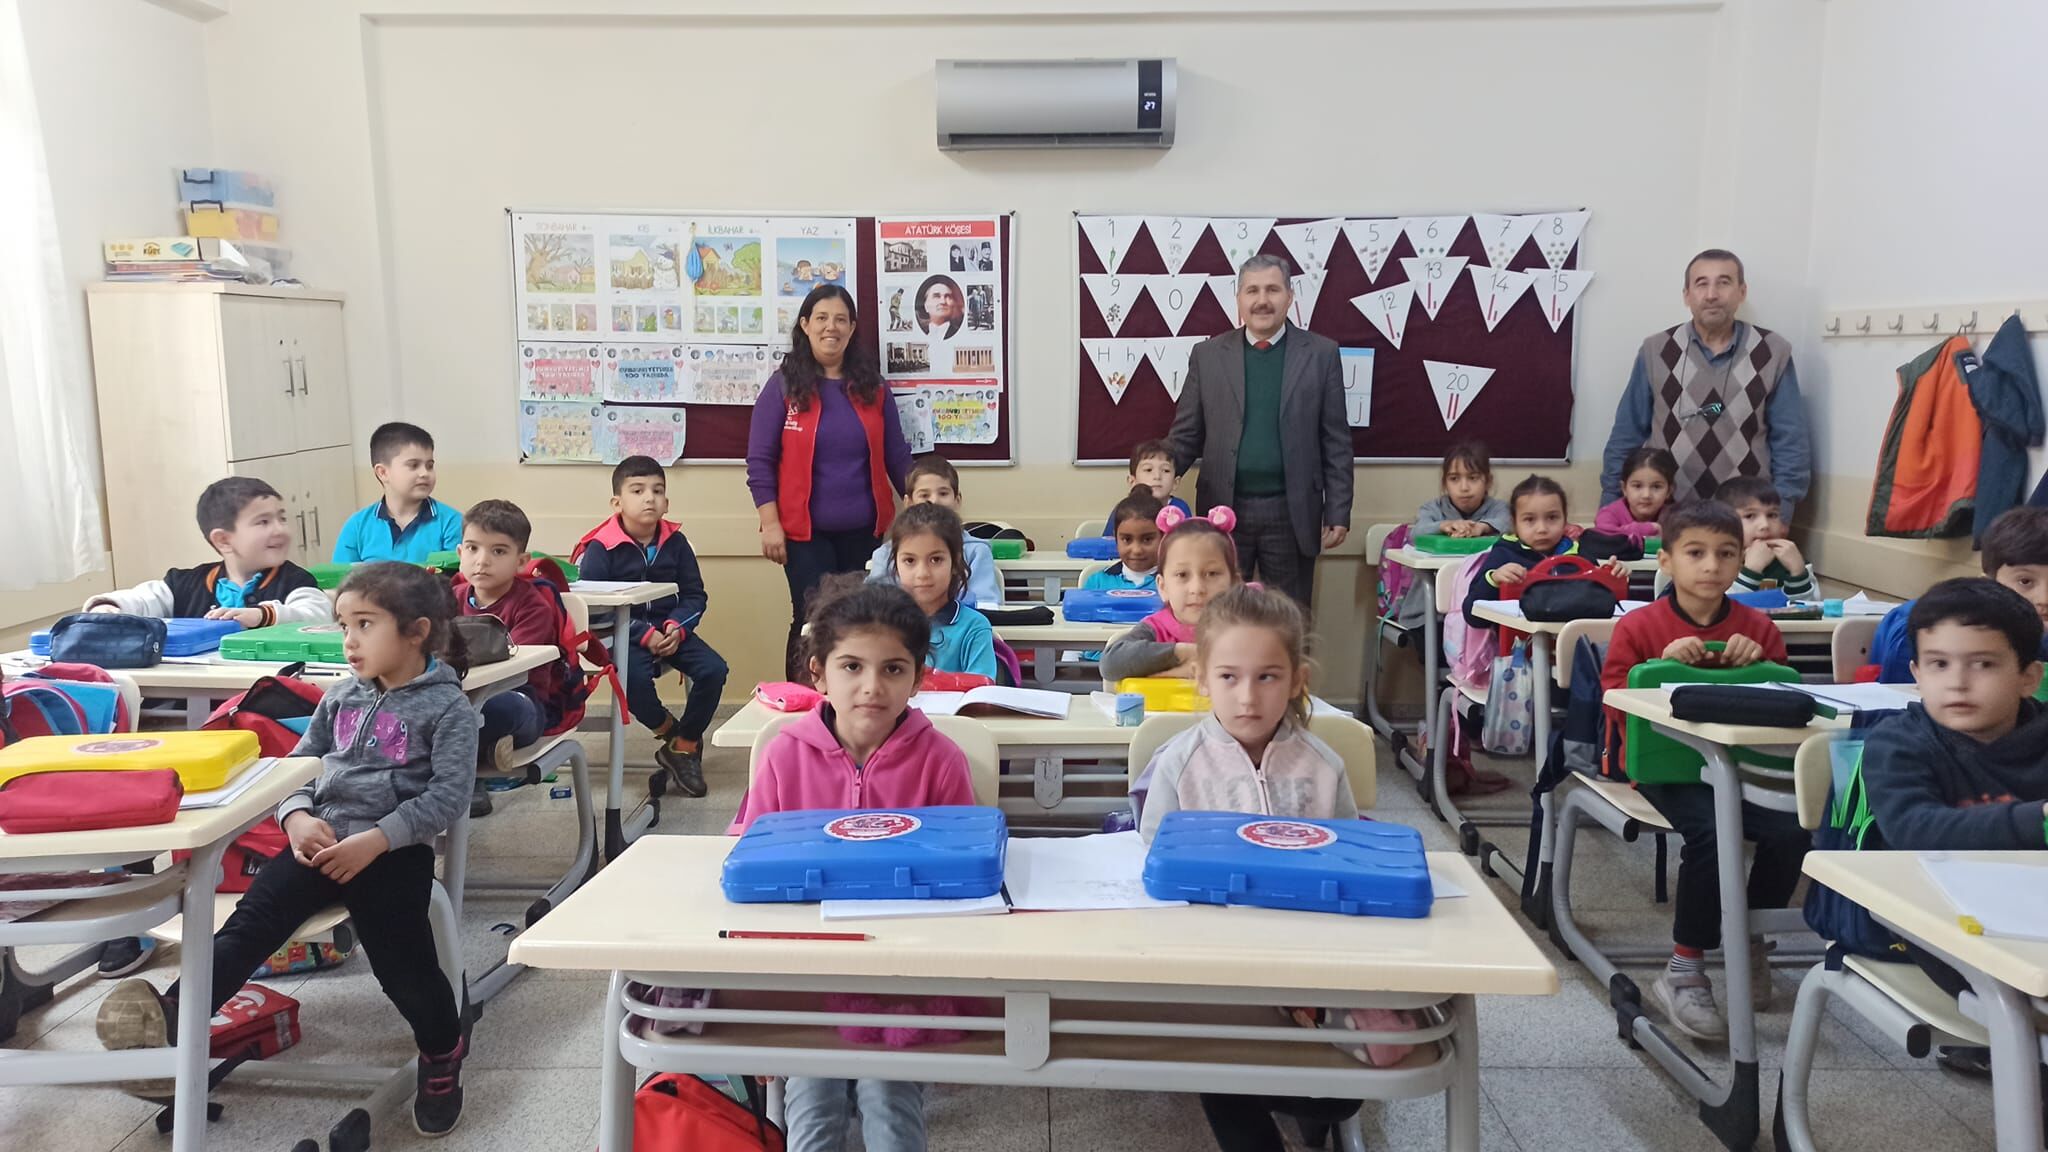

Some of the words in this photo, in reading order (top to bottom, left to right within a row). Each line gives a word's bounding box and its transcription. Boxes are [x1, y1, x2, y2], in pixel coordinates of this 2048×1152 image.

[1144, 101, 1156, 111] 27
[800, 226, 819, 236] YAZ
[904, 223, 943, 235] ATATÜRK
[945, 223, 972, 235] KÖŞESİ
[1108, 218, 1115, 238] 1
[1171, 221, 1182, 239] 2
[1237, 221, 1248, 240] 3
[1369, 223, 1380, 242] 5
[1426, 220, 1438, 239] 6
[1500, 219, 1512, 237] 7
[1552, 217, 1564, 235] 8
[1304, 228, 1318, 245] 4
[1425, 261, 1442, 279] 13
[1110, 278, 1120, 296] 9
[1491, 274, 1509, 293] 14
[1551, 273, 1569, 292] 15
[1168, 288, 1183, 310] 0
[1378, 291, 1397, 311] 12
[1097, 345, 1110, 362] H
[1126, 345, 1136, 362] h
[1153, 345, 1166, 361] V
[1446, 372, 1470, 392] 20
[1354, 396, 1363, 424] j
